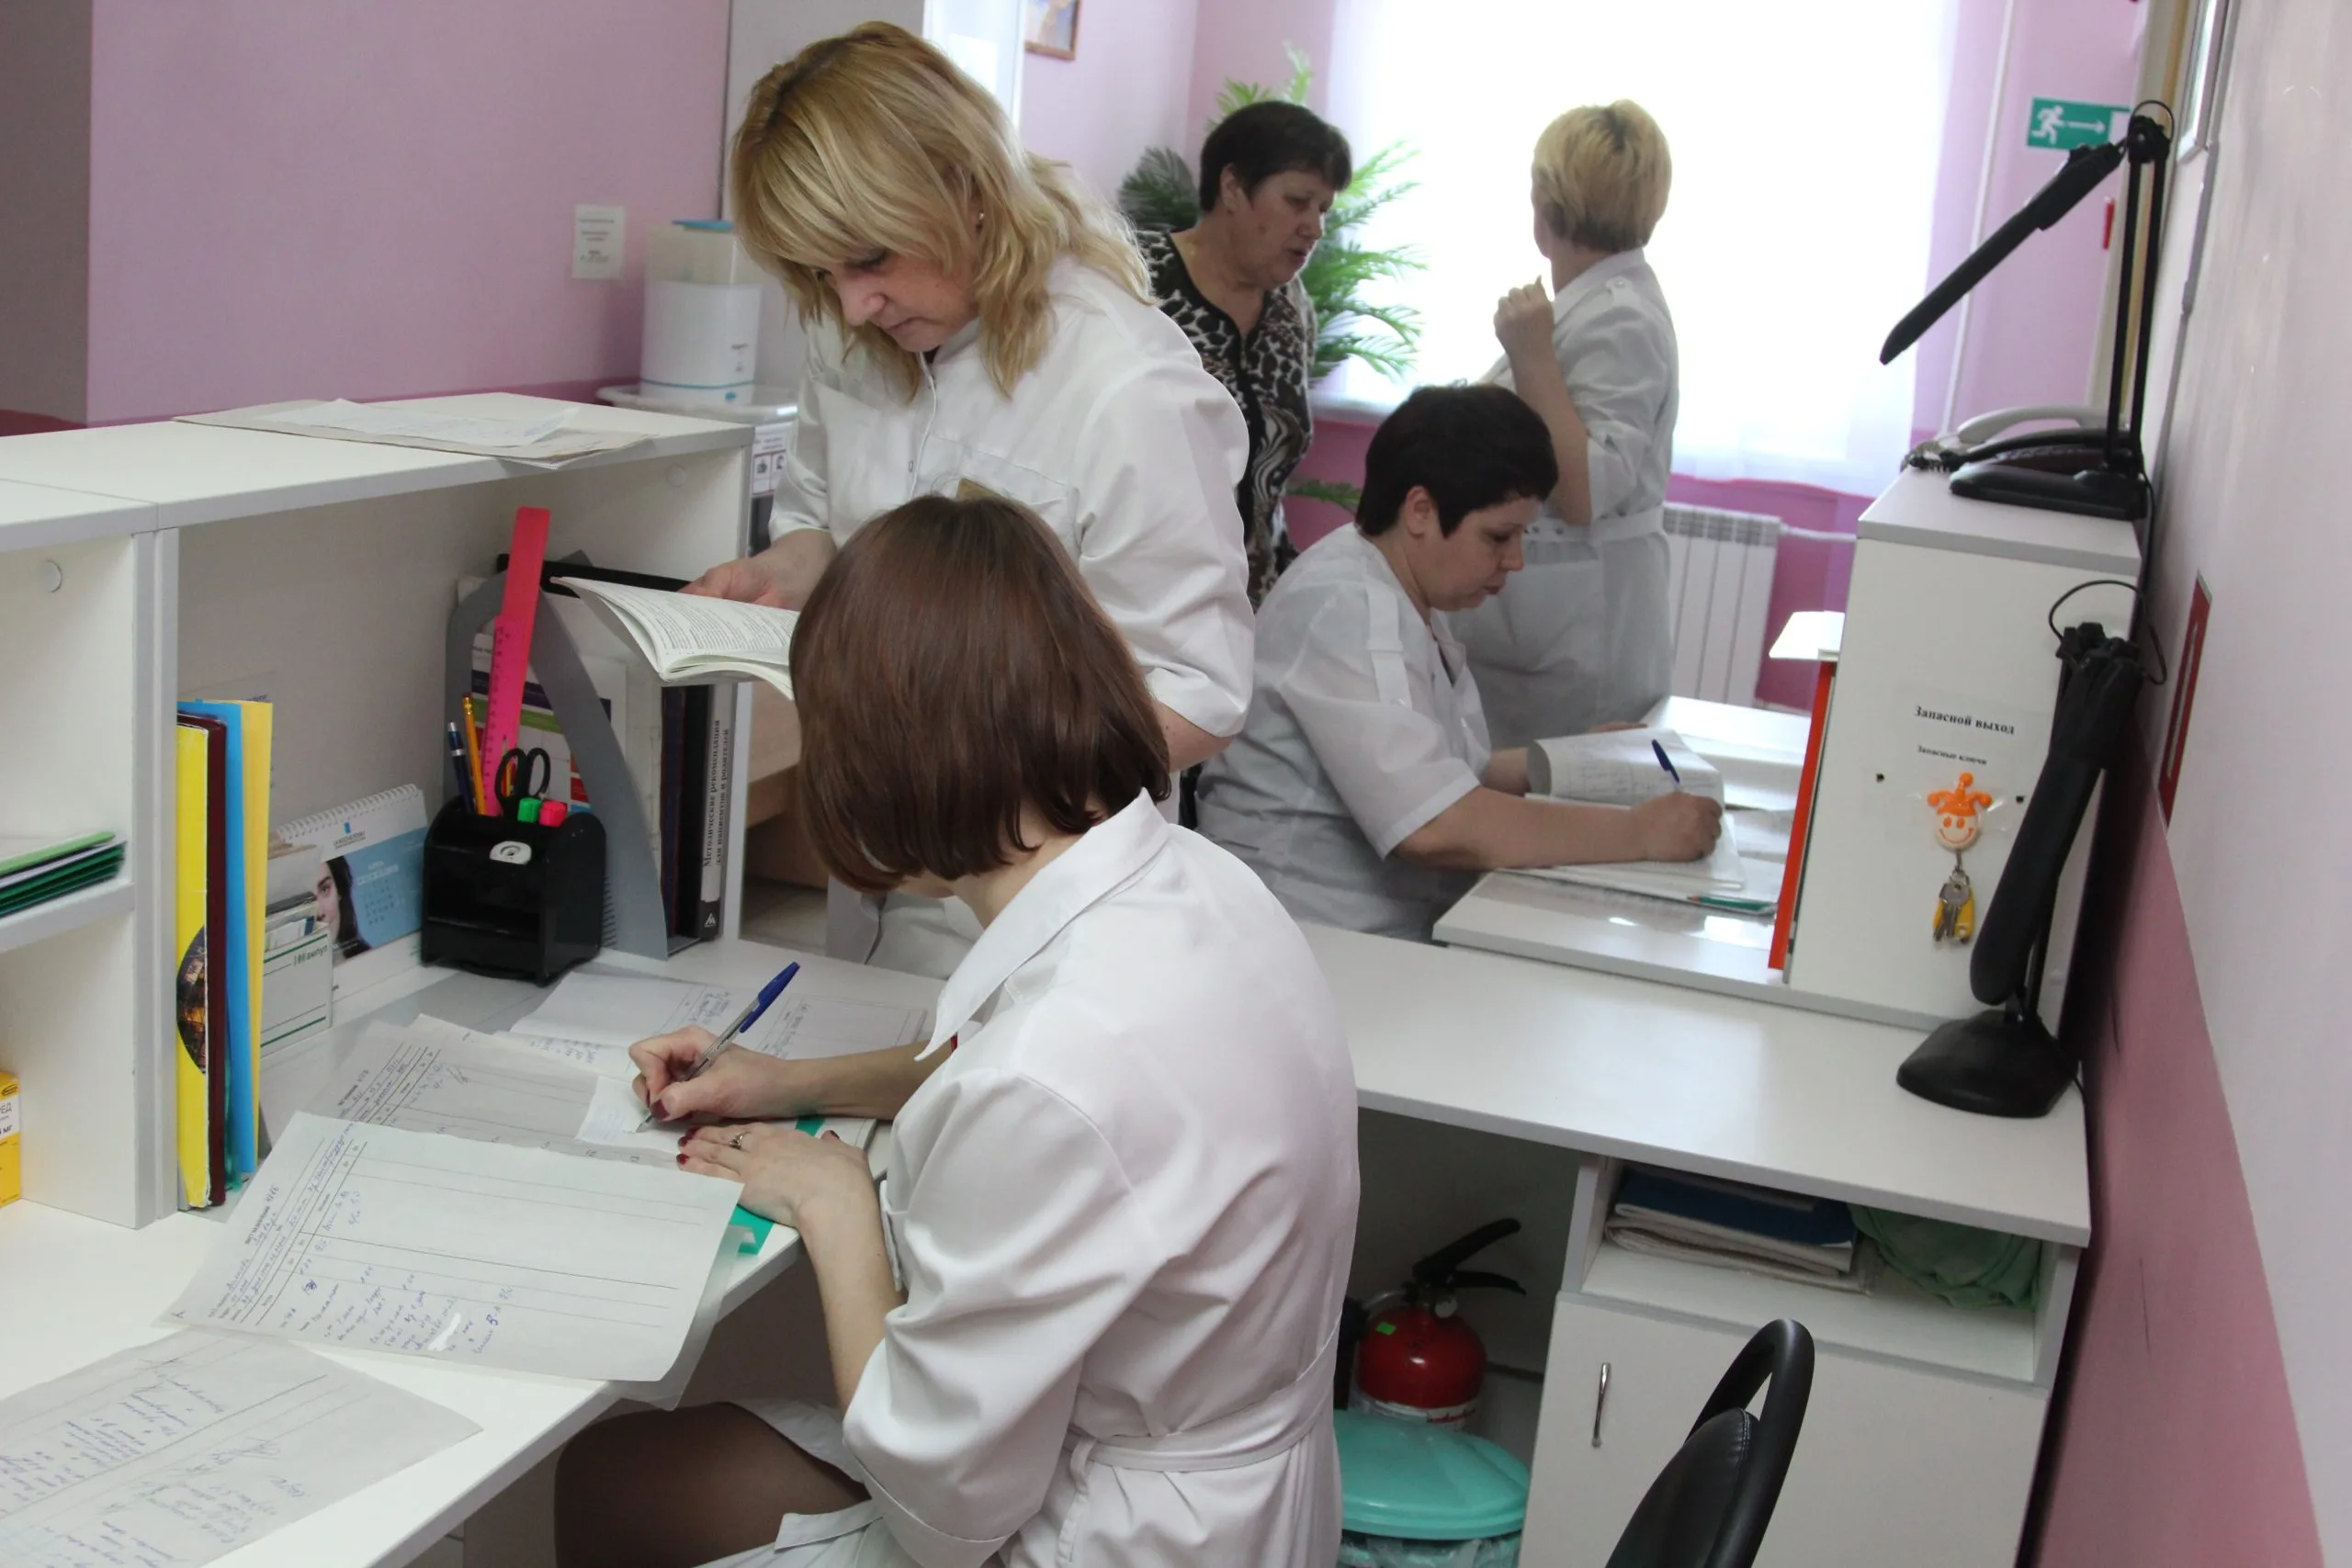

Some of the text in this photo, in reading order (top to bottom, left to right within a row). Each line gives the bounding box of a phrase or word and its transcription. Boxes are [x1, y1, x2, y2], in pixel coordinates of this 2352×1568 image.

[1915, 705, 2015, 736] Запасной выход
[720, 728, 729, 781] родителей
[704, 719, 720, 867] Методические рекомендации
[717, 792, 726, 845] пациентов
